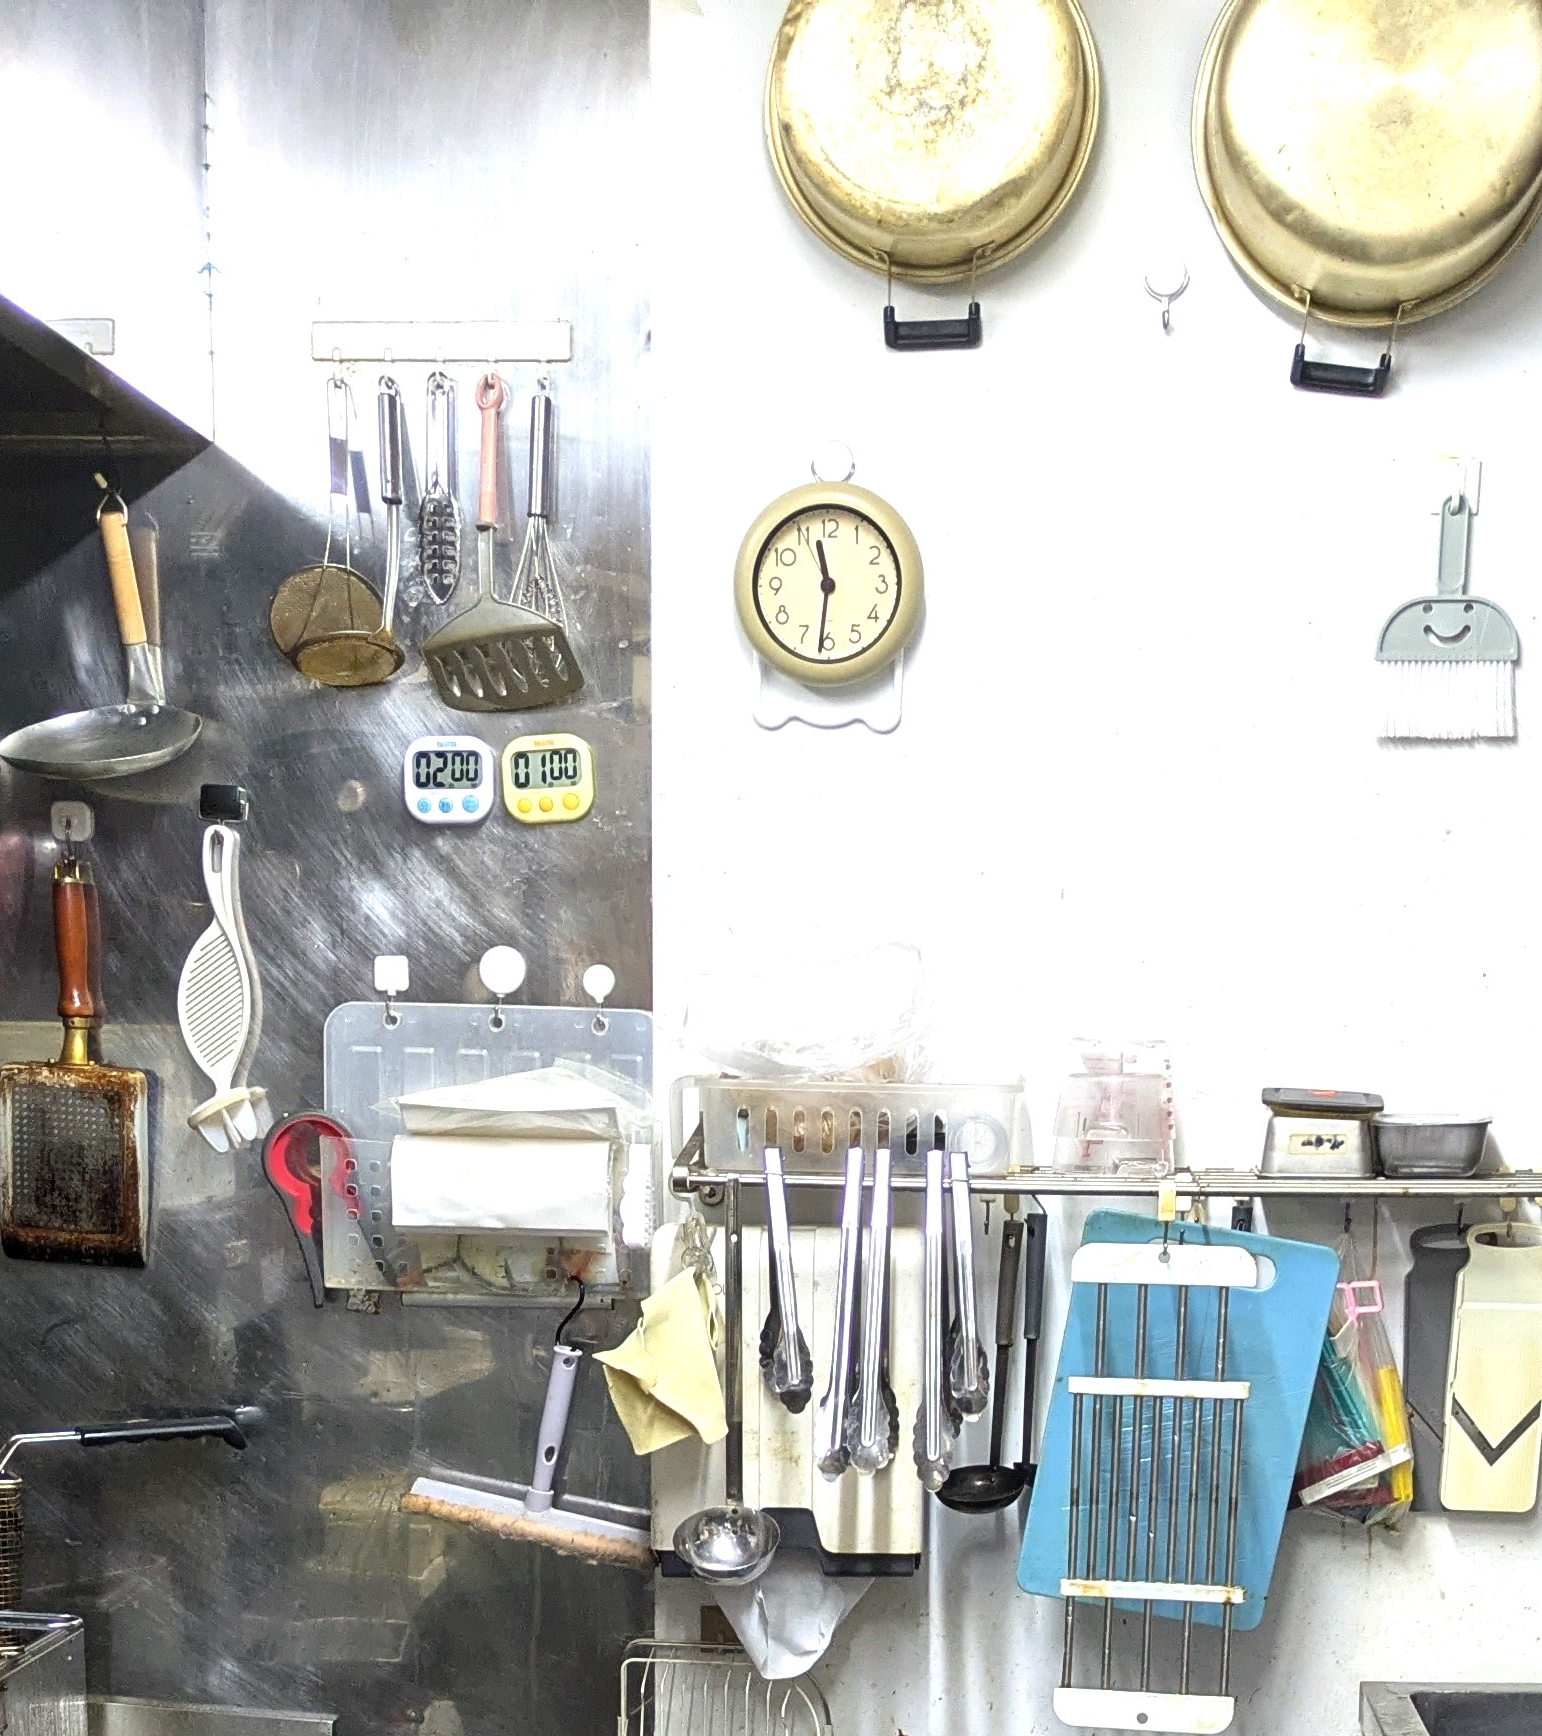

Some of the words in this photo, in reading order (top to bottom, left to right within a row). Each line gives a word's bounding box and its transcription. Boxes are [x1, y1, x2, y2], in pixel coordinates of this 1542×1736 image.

[822, 518, 839, 539] 12
[854, 525, 859, 544] 1
[775, 547, 797, 567] 10
[869, 547, 881, 566] 2
[769, 577, 782, 595] 9
[875, 575, 889, 594] 3
[775, 605, 789, 625] 8
[867, 604, 880, 622] 4
[799, 624, 809, 644] 7
[849, 624, 861, 644] 5
